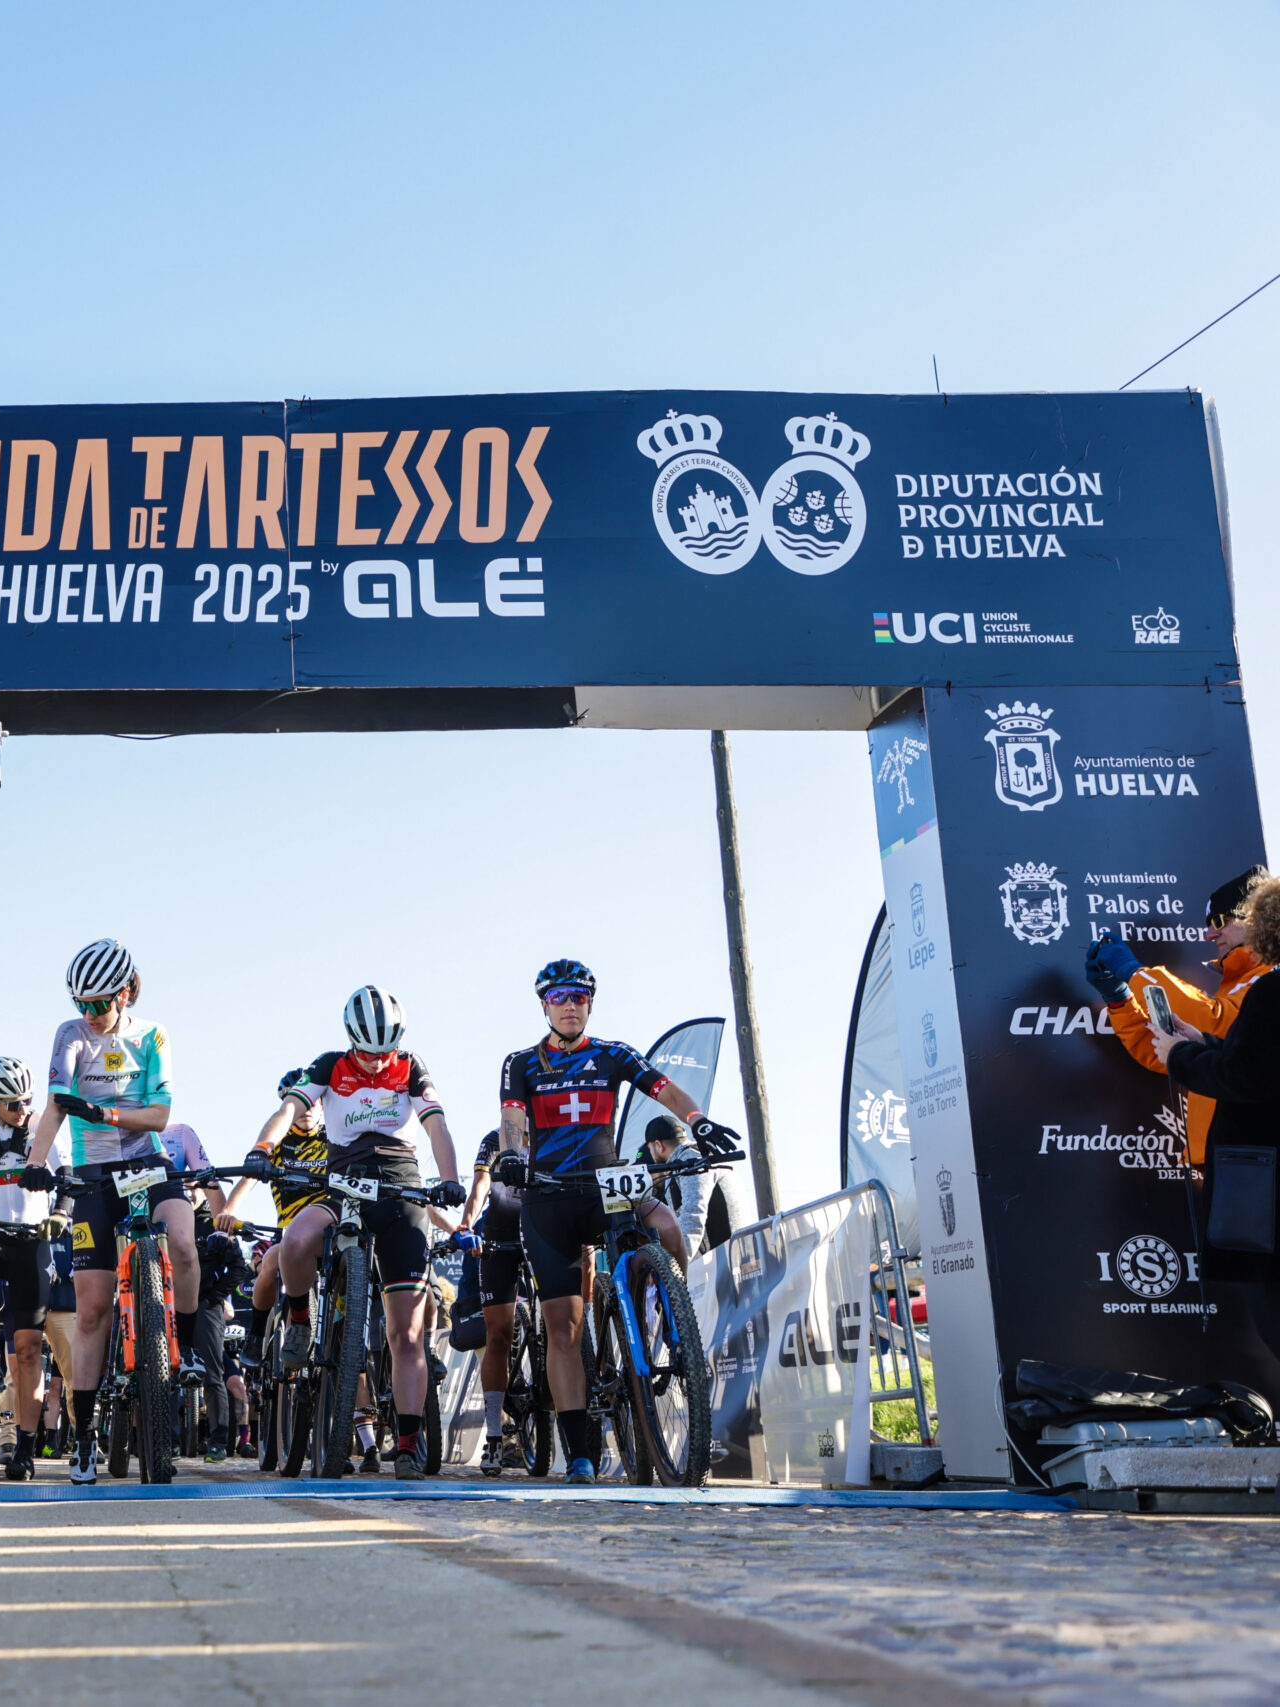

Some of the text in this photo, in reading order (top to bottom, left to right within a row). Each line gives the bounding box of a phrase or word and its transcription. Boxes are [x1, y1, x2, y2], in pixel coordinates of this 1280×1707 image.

[131, 426, 553, 549] TARTESSOS
[895, 465, 1103, 498] DIPUTACIÓN
[898, 502, 1104, 528] PROVINCIAL
[128, 506, 168, 549] DE
[934, 533, 1066, 559] HUELVA
[192, 560, 312, 623] 2025
[320, 559, 339, 576] by
[982, 613, 1018, 621] UNION
[891, 612, 977, 644] UCI
[984, 624, 1031, 633] CYCLISTE
[1134, 630, 1180, 644] RACE
[984, 634, 1074, 644] INTERNATIONALE
[1074, 755, 1195, 770] Ayuntamiento de
[1075, 774, 1199, 796] HUELVA
[1084, 872, 1177, 886] Ayuntamiento
[1087, 894, 1184, 915] Palos de
[1118, 921, 1215, 942] Fronter
[908, 941, 935, 970] Lepe
[84, 1072, 140, 1083] megamo
[536, 1079, 609, 1092] BULLS
[909, 1073, 962, 1105] San Bartolomé
[344, 1107, 401, 1128] Naturfreunde
[917, 1095, 957, 1119] de la Torre
[1039, 1125, 1174, 1156] Fundación
[1119, 1152, 1172, 1169] CAJA
[1157, 1169, 1185, 1180] DEL
[605, 1173, 646, 1198] 103
[933, 1254, 974, 1275] El Granado
[1103, 1303, 1218, 1314] SPORT BEARINGS
